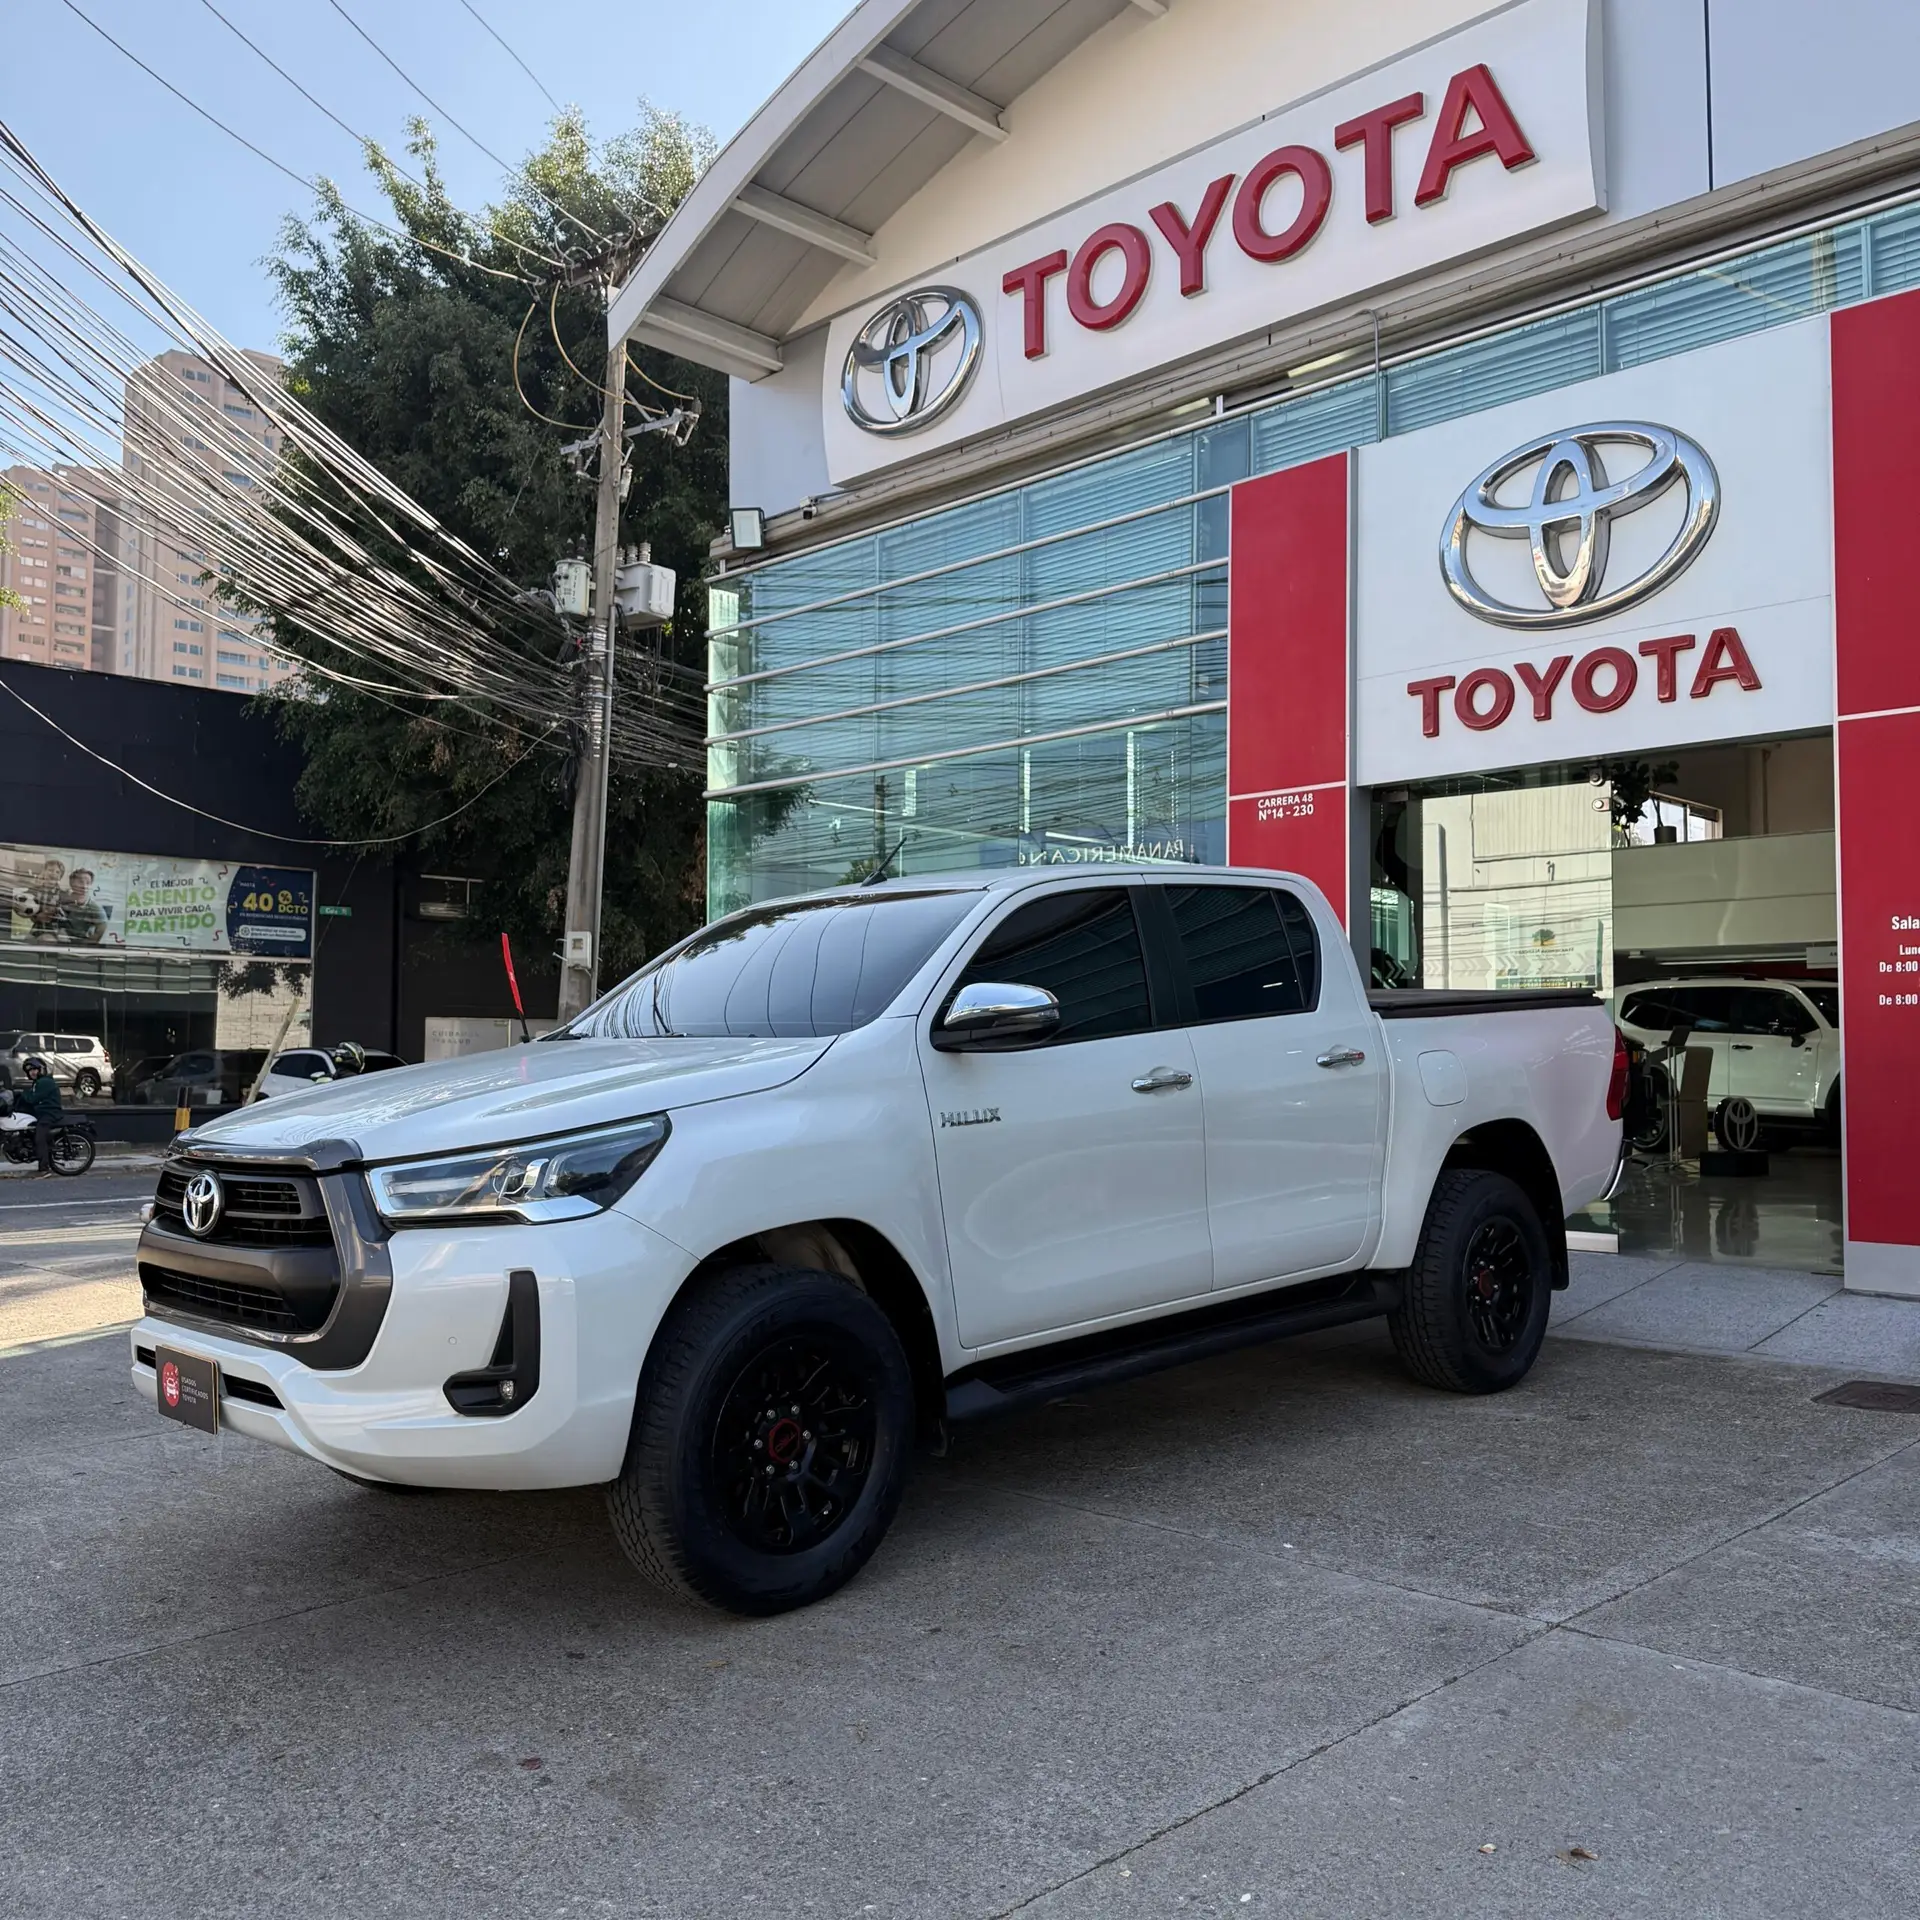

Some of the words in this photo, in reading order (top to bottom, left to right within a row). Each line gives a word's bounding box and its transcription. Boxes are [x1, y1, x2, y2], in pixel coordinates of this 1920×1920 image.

[1002, 63, 1538, 361] TOYOTA
[1407, 627, 1761, 738] TOYOTA
[1258, 795, 1300, 808] CARRERA
[1302, 793, 1313, 803] 48
[1293, 804, 1314, 817] 230
[162, 878, 194, 887] MEJOR
[127, 886, 217, 907] ASIENTO
[242, 892, 274, 912] 40
[130, 908, 156, 918] PARA
[158, 906, 183, 916] VIVIR
[185, 904, 211, 913] CADA
[278, 904, 308, 914] DCTO
[125, 912, 217, 933] PARTIDO
[1879, 962, 1892, 972] De
[1896, 961, 1918, 972] 8:00
[1879, 994, 1892, 1005] De
[1896, 994, 1918, 1005] 8:00
[940, 1107, 1002, 1128] HILUX
[181, 1376, 197, 1387] USADOS
